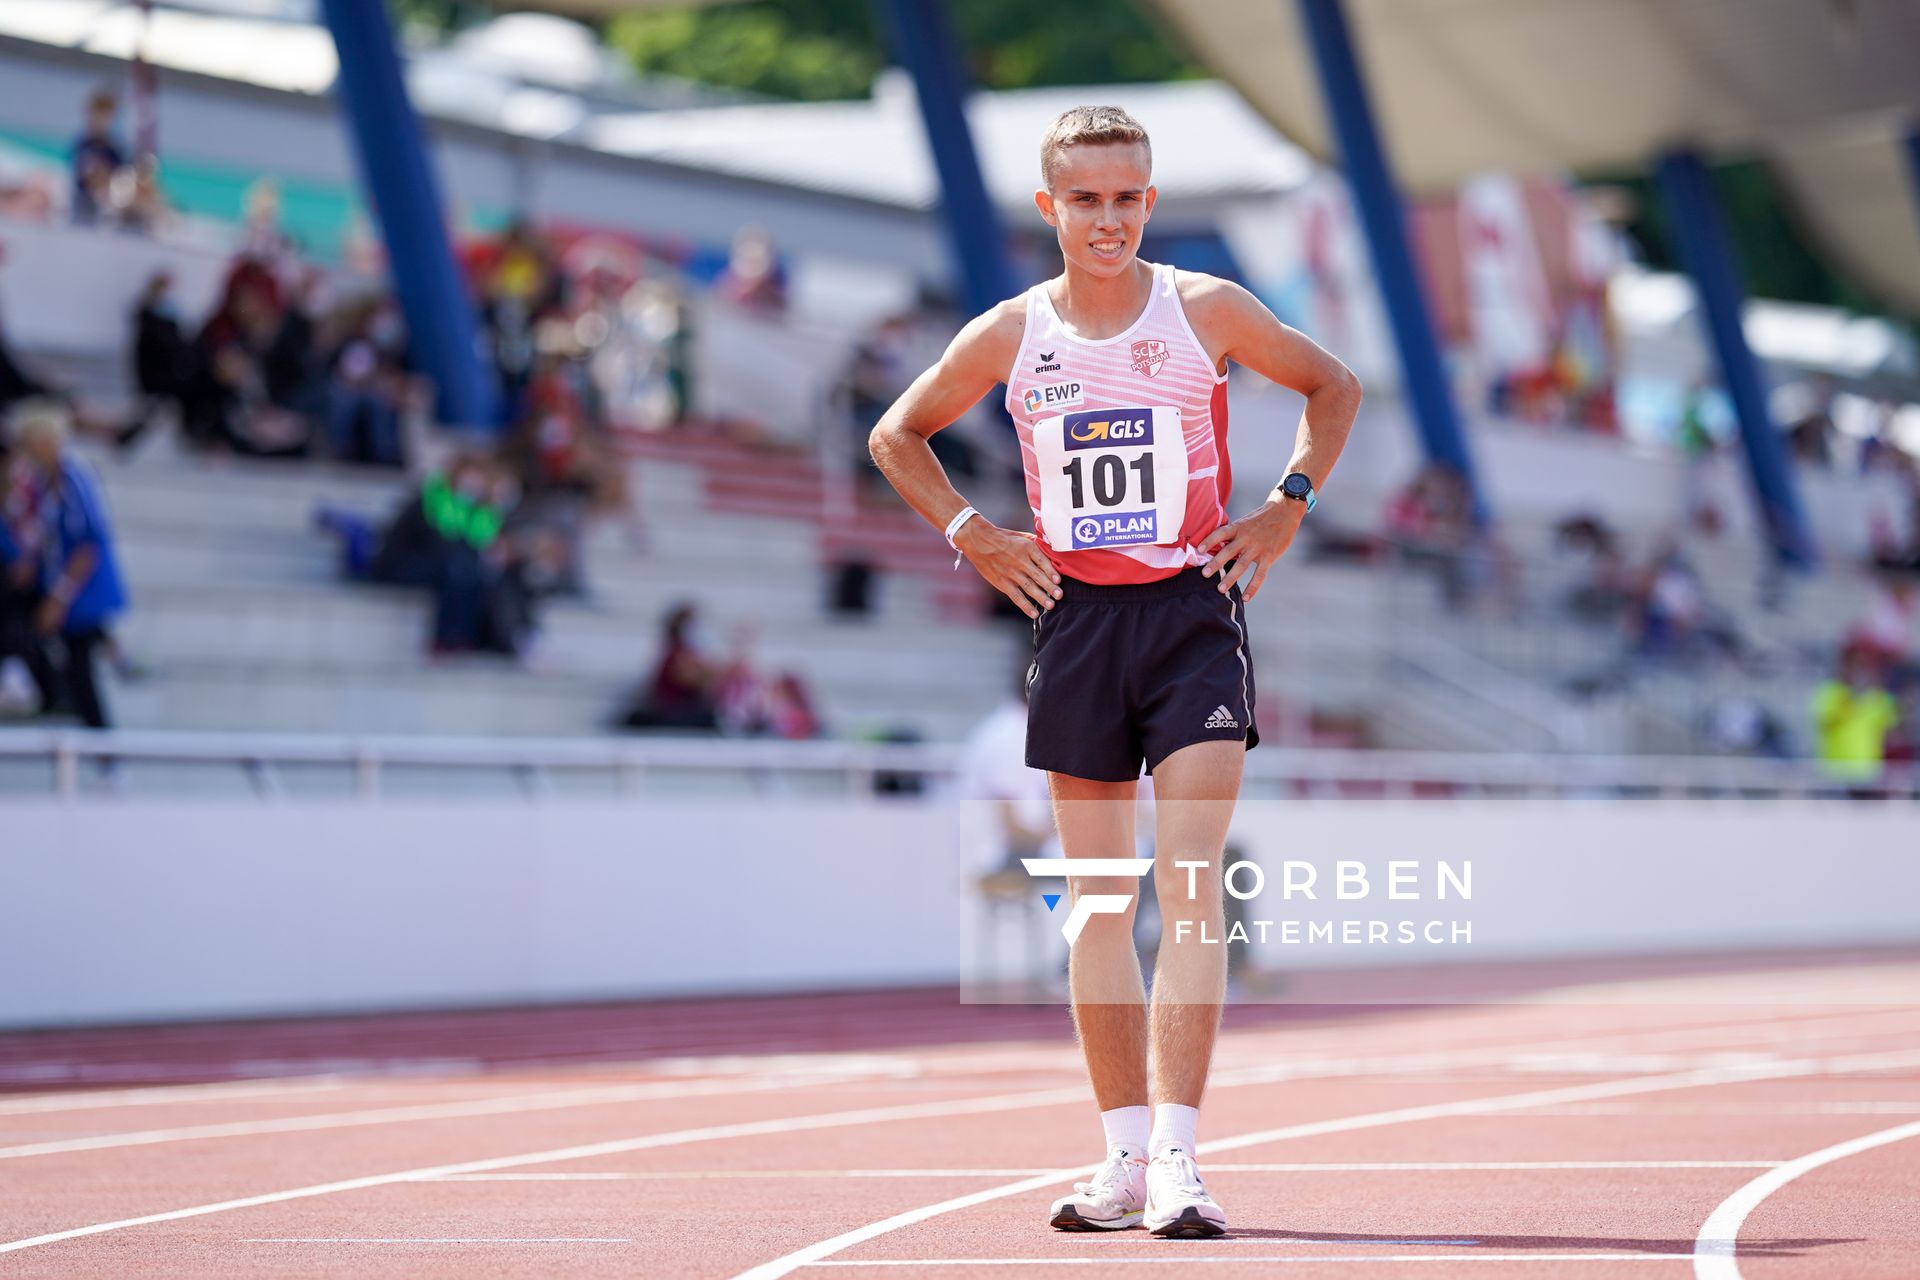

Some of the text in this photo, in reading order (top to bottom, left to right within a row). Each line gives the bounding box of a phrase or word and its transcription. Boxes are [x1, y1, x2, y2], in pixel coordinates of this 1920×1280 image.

[1132, 352, 1169, 371] POTSDAM
[1134, 346, 1148, 360] SC
[1035, 363, 1061, 374] erima
[1045, 383, 1080, 402] EWP
[1109, 419, 1145, 439] GLS
[1062, 452, 1155, 508] 101
[1104, 517, 1153, 534] PLAN
[1105, 533, 1153, 541] INTERNATIONAL
[1205, 719, 1239, 729] adidas
